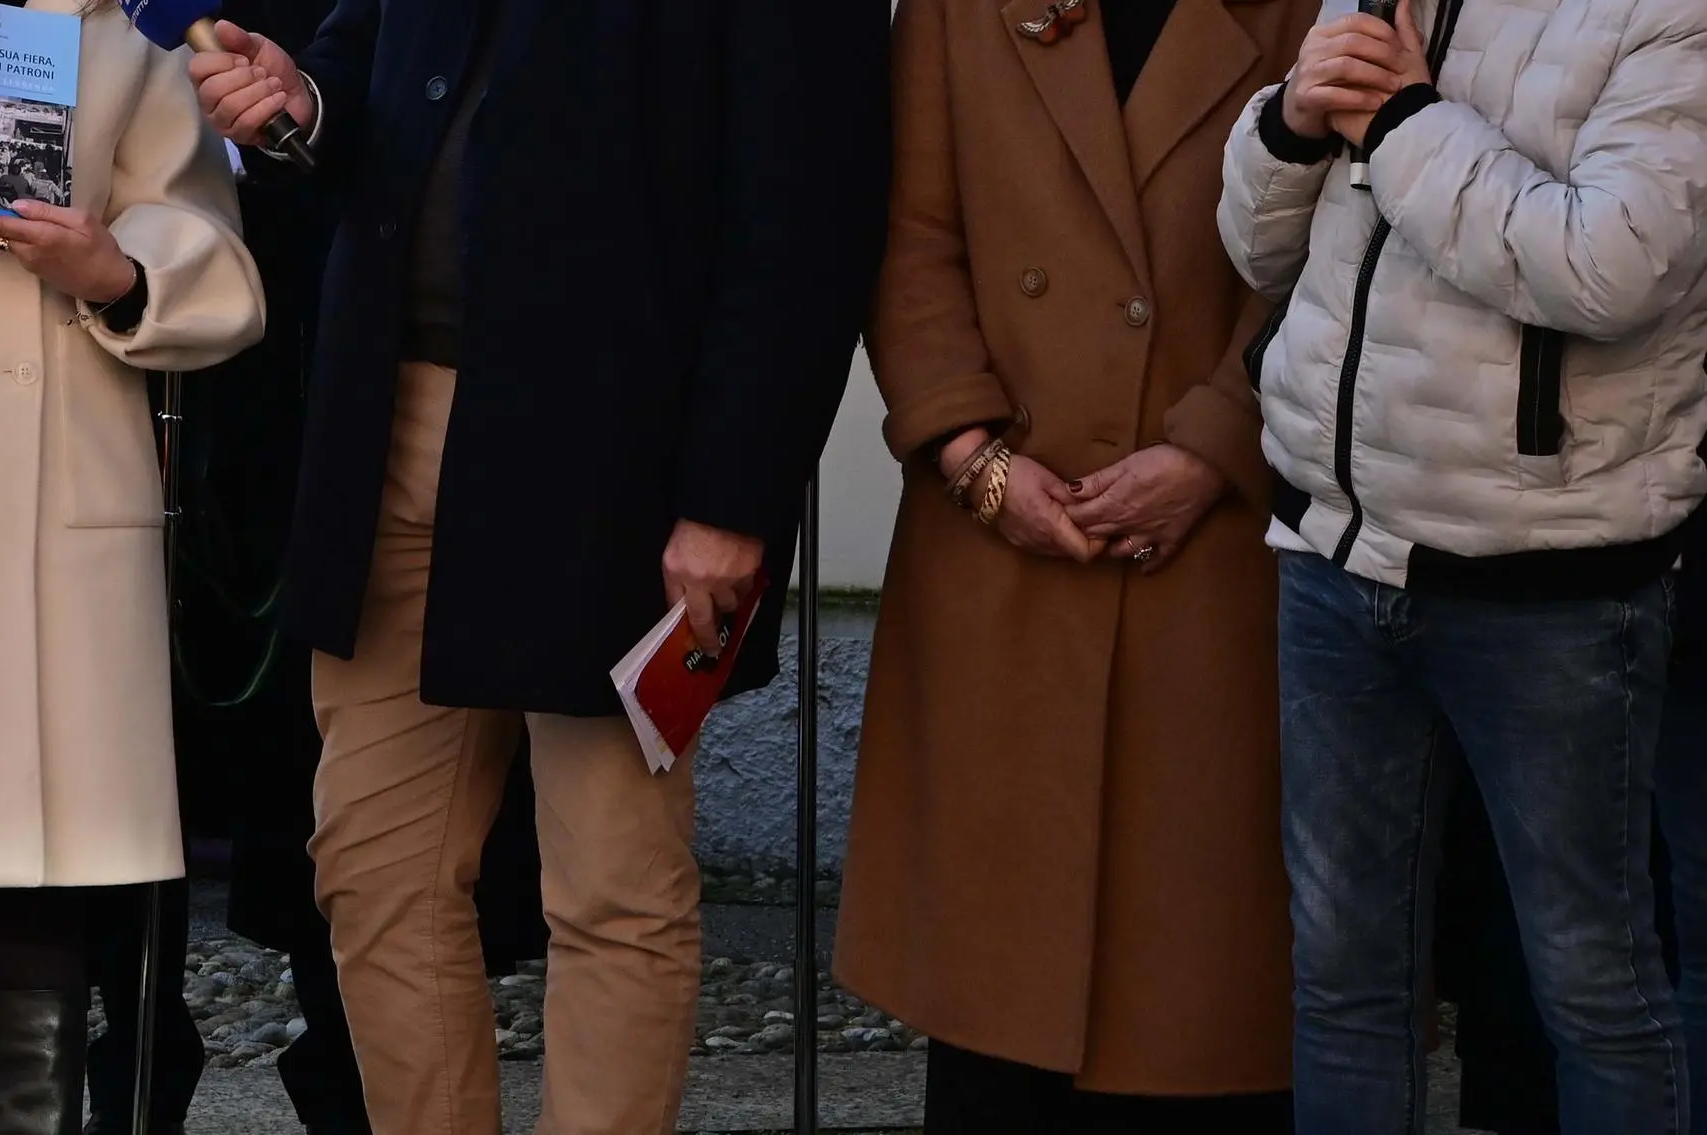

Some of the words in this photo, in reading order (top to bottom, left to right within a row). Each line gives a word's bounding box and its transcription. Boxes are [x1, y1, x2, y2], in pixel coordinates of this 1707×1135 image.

[0, 48, 20, 62] SUA
[23, 53, 56, 68] FIERA,
[6, 63, 55, 80] PATRONI
